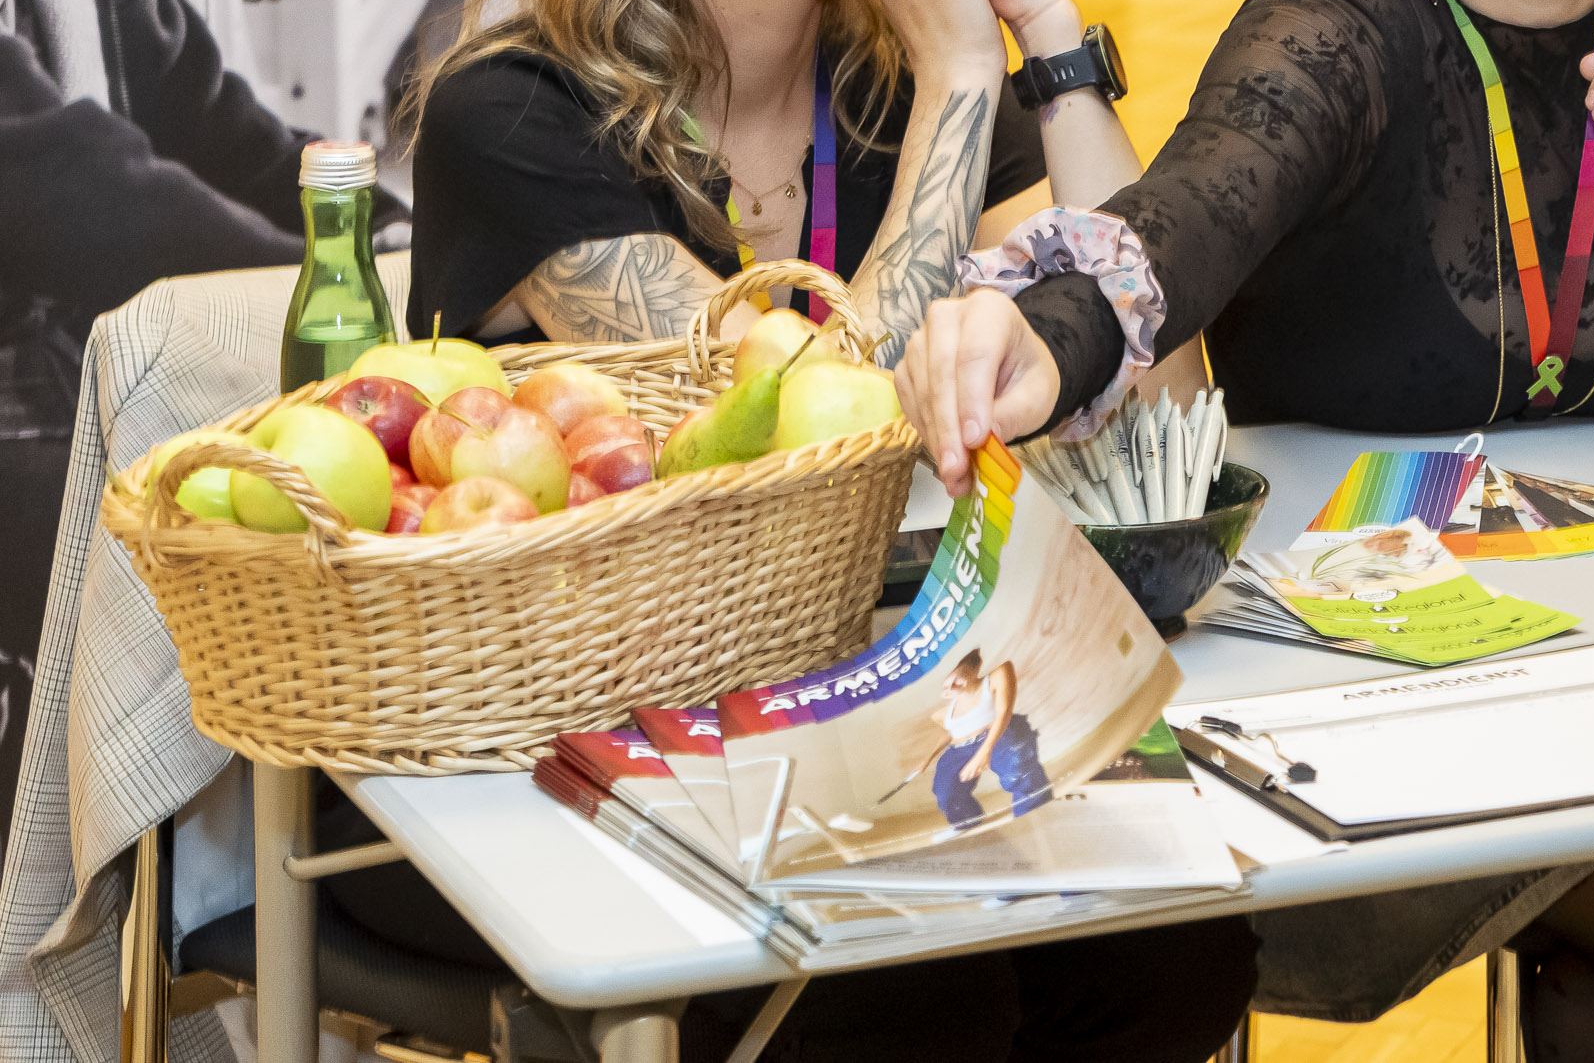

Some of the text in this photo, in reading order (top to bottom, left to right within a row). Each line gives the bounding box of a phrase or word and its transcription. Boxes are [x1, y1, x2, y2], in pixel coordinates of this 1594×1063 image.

[1388, 593, 1467, 614] Regional
[1405, 618, 1482, 636] Regional
[1342, 668, 1531, 701] ARMENDIENST
